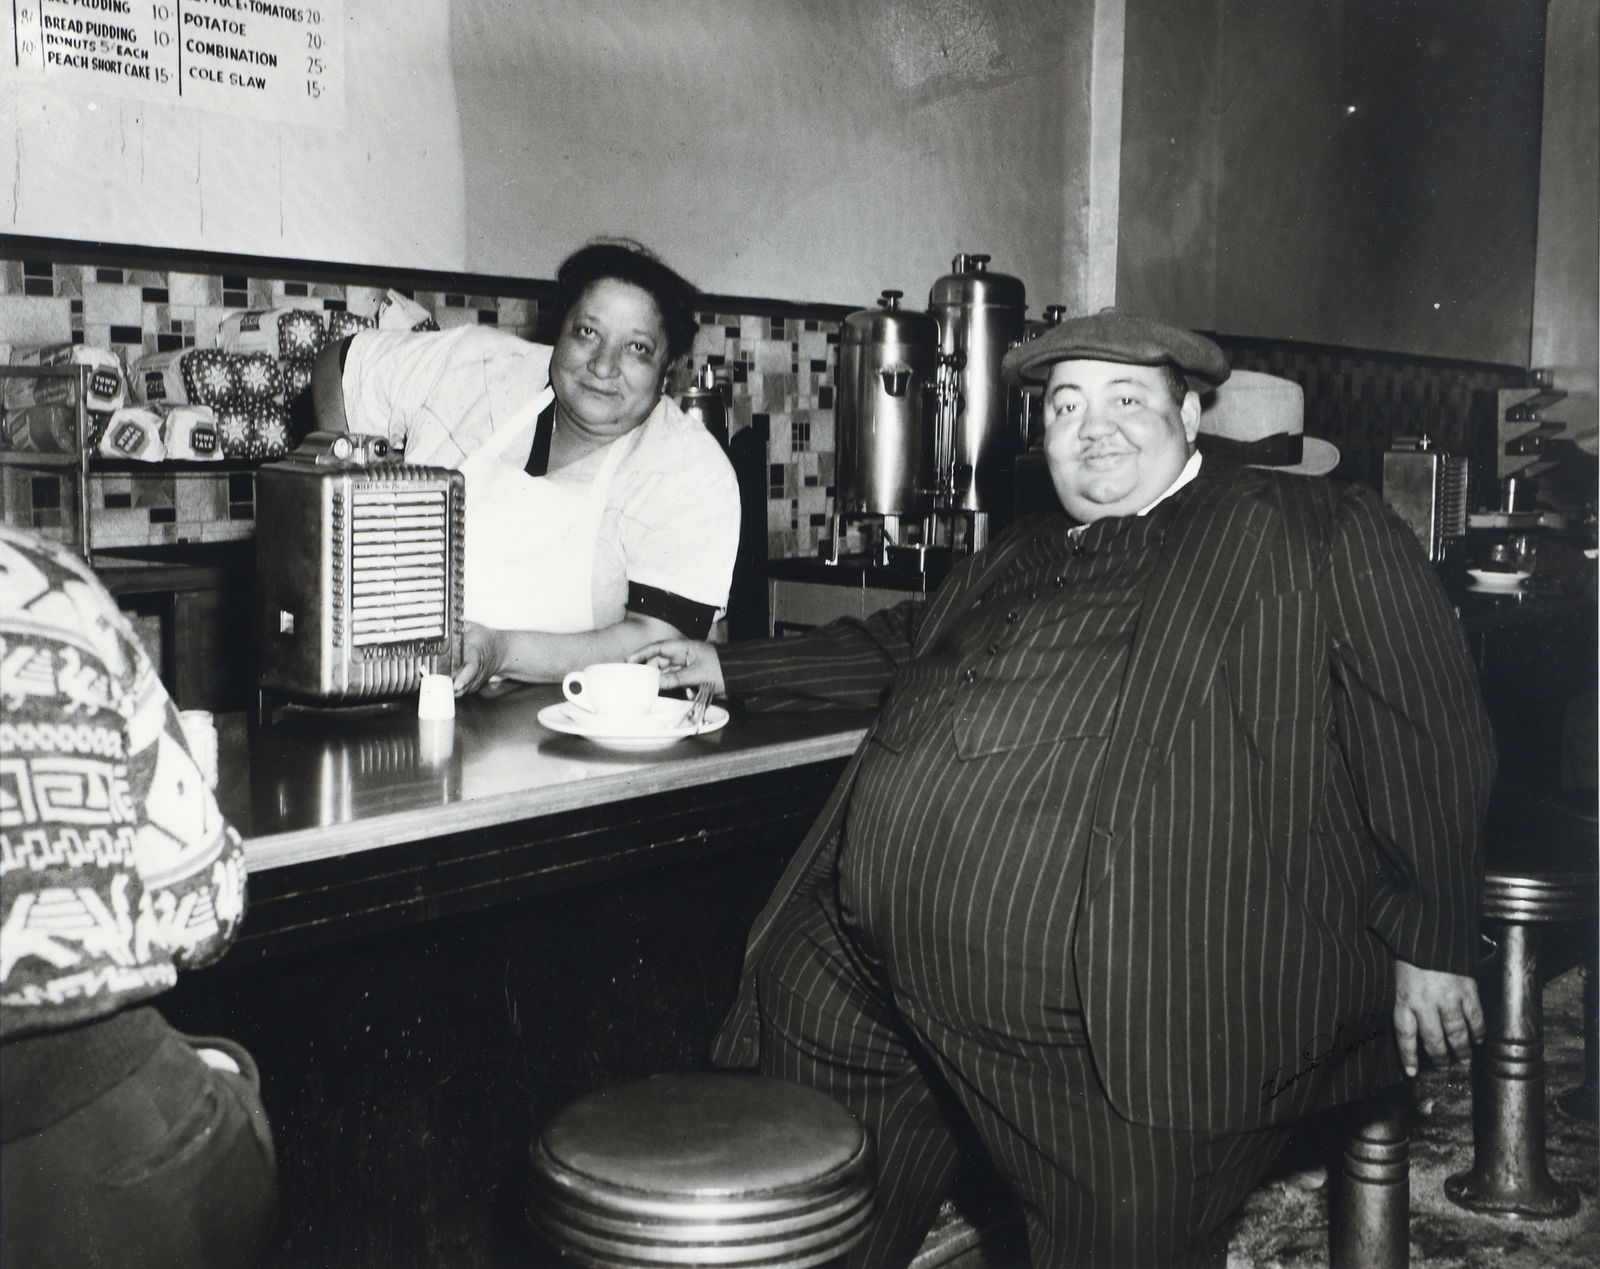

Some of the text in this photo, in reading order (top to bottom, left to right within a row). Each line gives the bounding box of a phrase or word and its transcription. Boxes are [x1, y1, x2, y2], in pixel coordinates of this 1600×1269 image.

[45, 15, 83, 34] BREAD
[86, 21, 137, 43] PUDDING
[184, 12, 247, 37] POTATOE
[46, 33, 96, 53] DONUTS
[116, 44, 149, 60] EACH
[186, 38, 277, 68] COMBINATION
[48, 50, 89, 70] PEACH
[91, 57, 122, 75] SHORT
[125, 63, 151, 80] CAKE
[189, 66, 223, 83] COLE
[229, 72, 266, 90] SLAW
[94, 383, 113, 395] TALK
[95, 375, 117, 387] TOWN
[195, 432, 215, 443] TOWN
[195, 441, 213, 450] TALK
